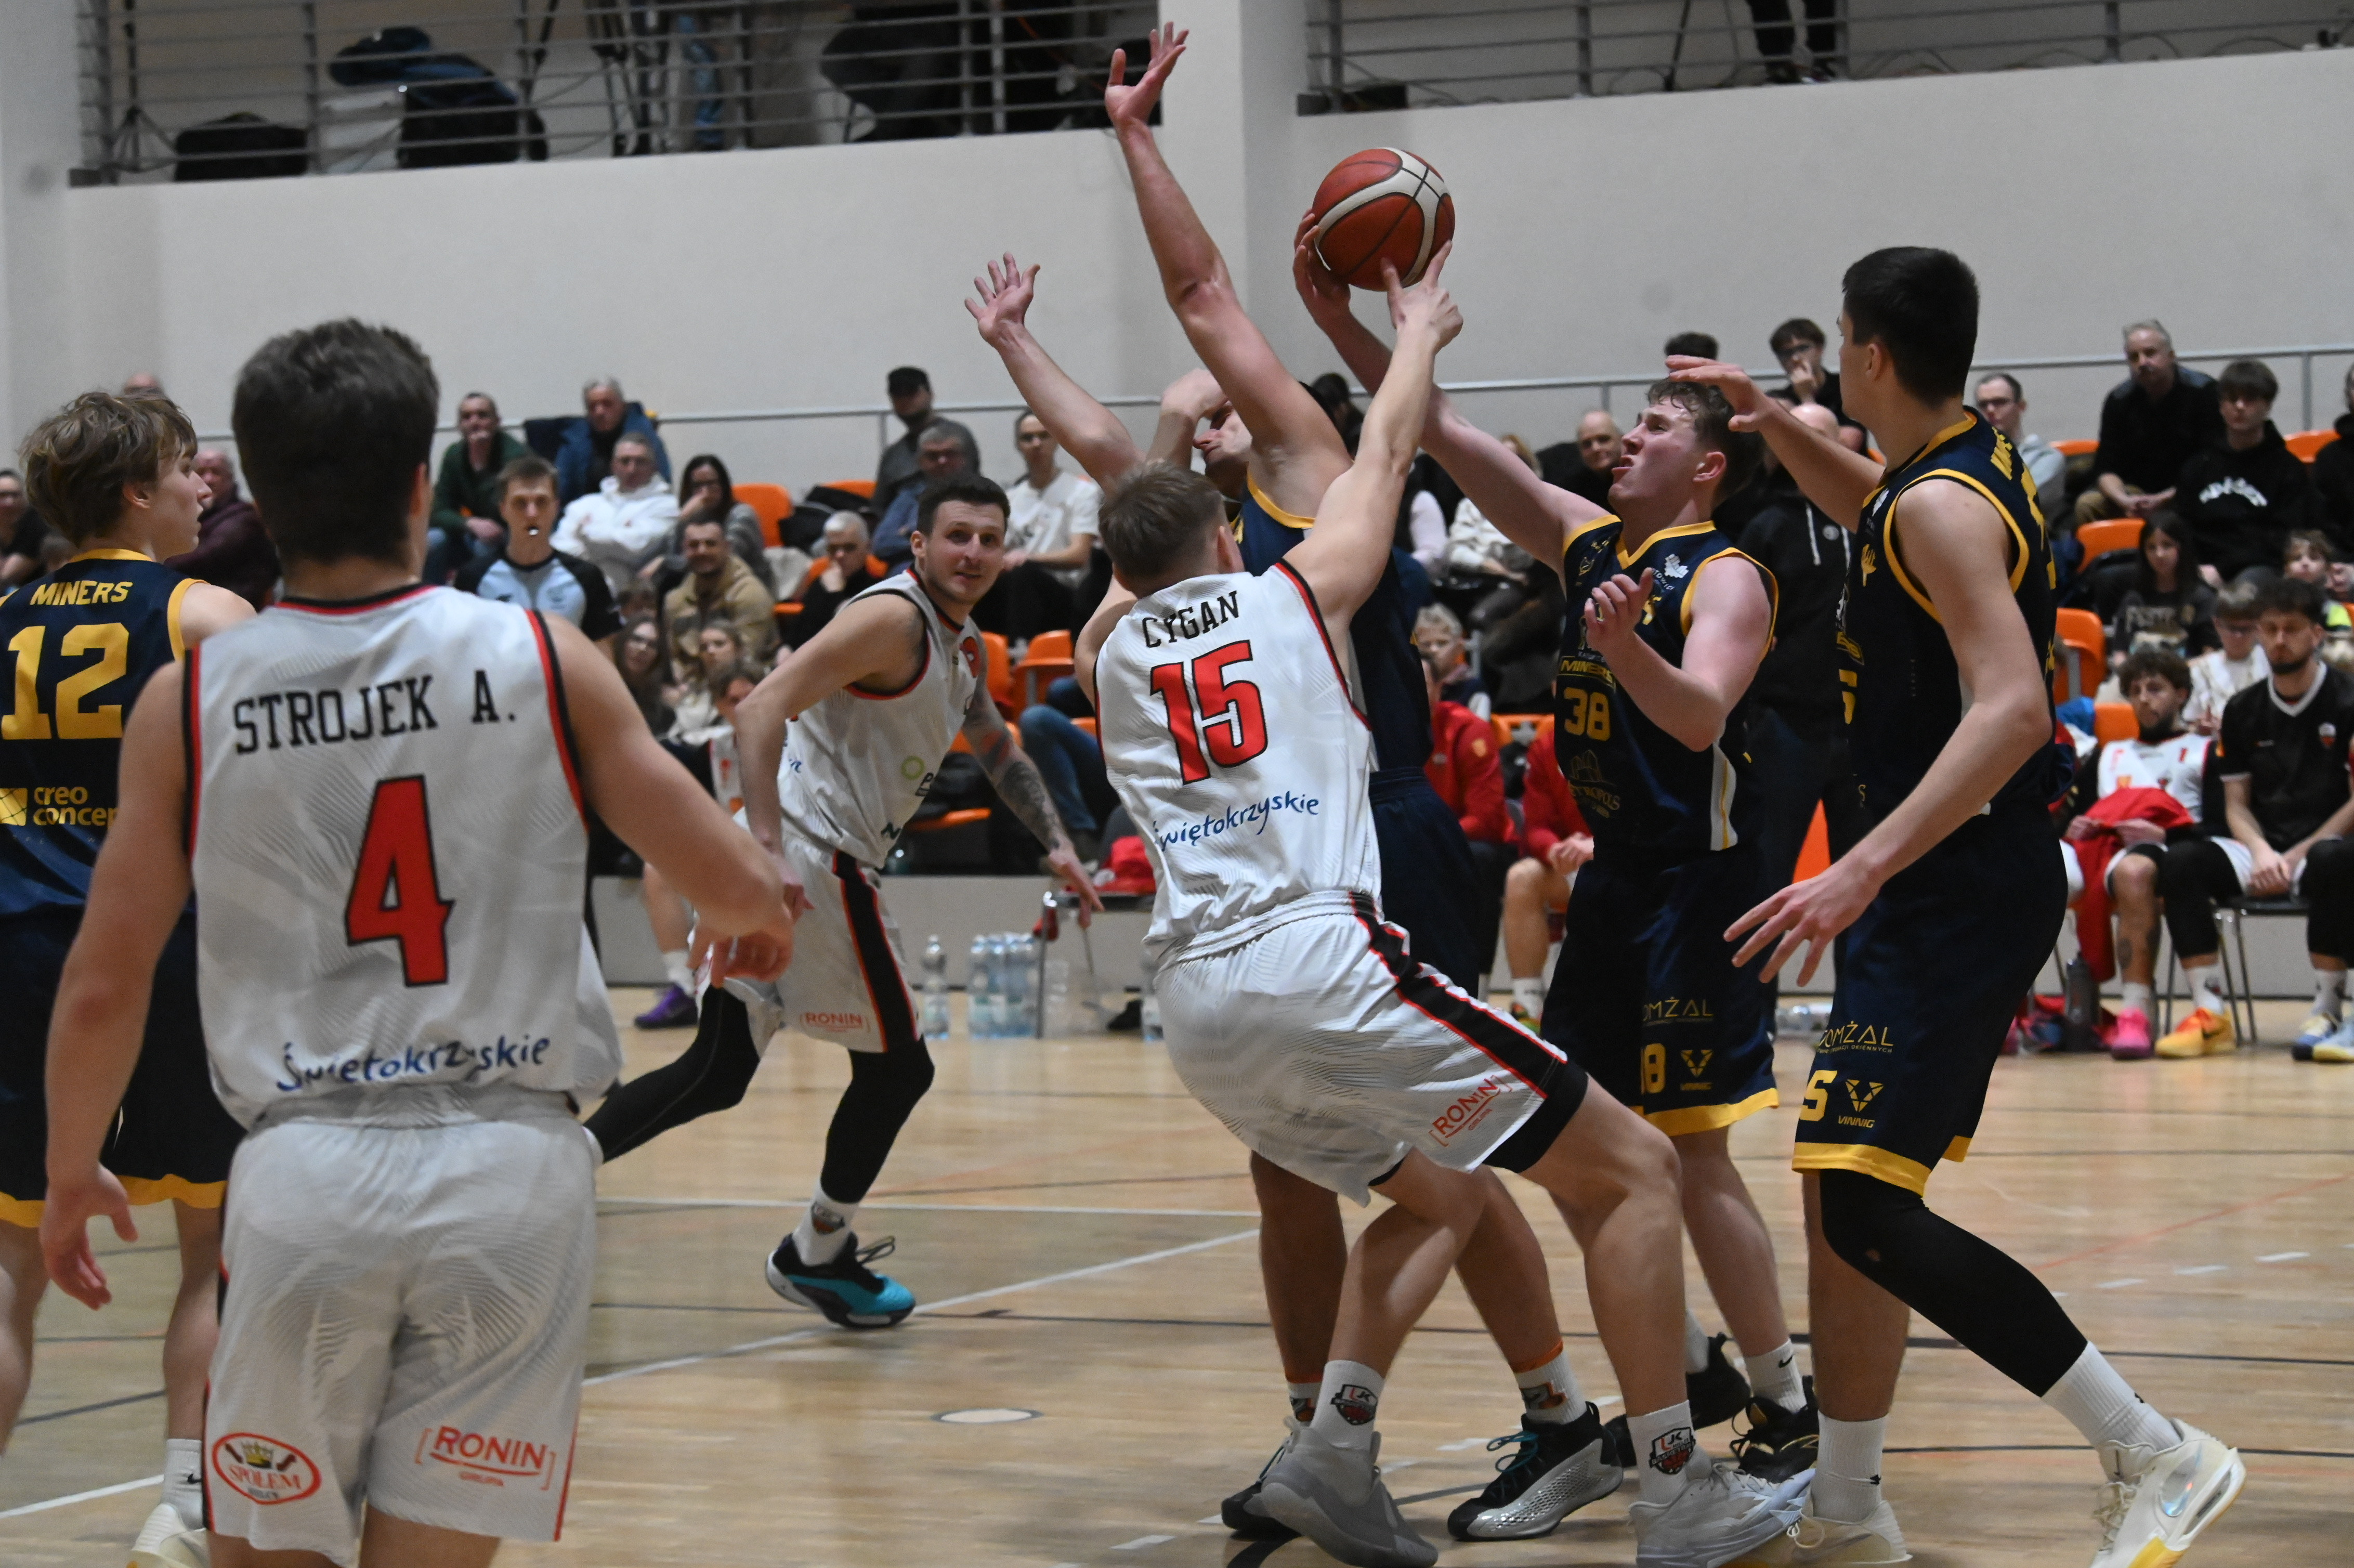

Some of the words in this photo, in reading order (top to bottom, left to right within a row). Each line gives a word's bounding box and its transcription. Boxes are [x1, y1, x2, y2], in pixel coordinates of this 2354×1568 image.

[30, 580, 133, 606] MINERS
[1142, 591, 1240, 648] CYGAN
[1, 622, 129, 740] 12
[233, 675, 438, 755] STROJEK
[472, 669, 516, 724] A.
[1149, 639, 1268, 785] 15
[1563, 687, 1611, 741] 38
[34, 786, 88, 805] creo
[344, 774, 456, 987] 4
[1431, 1078, 1499, 1135] RONIN
[434, 1426, 548, 1469] RONIN
